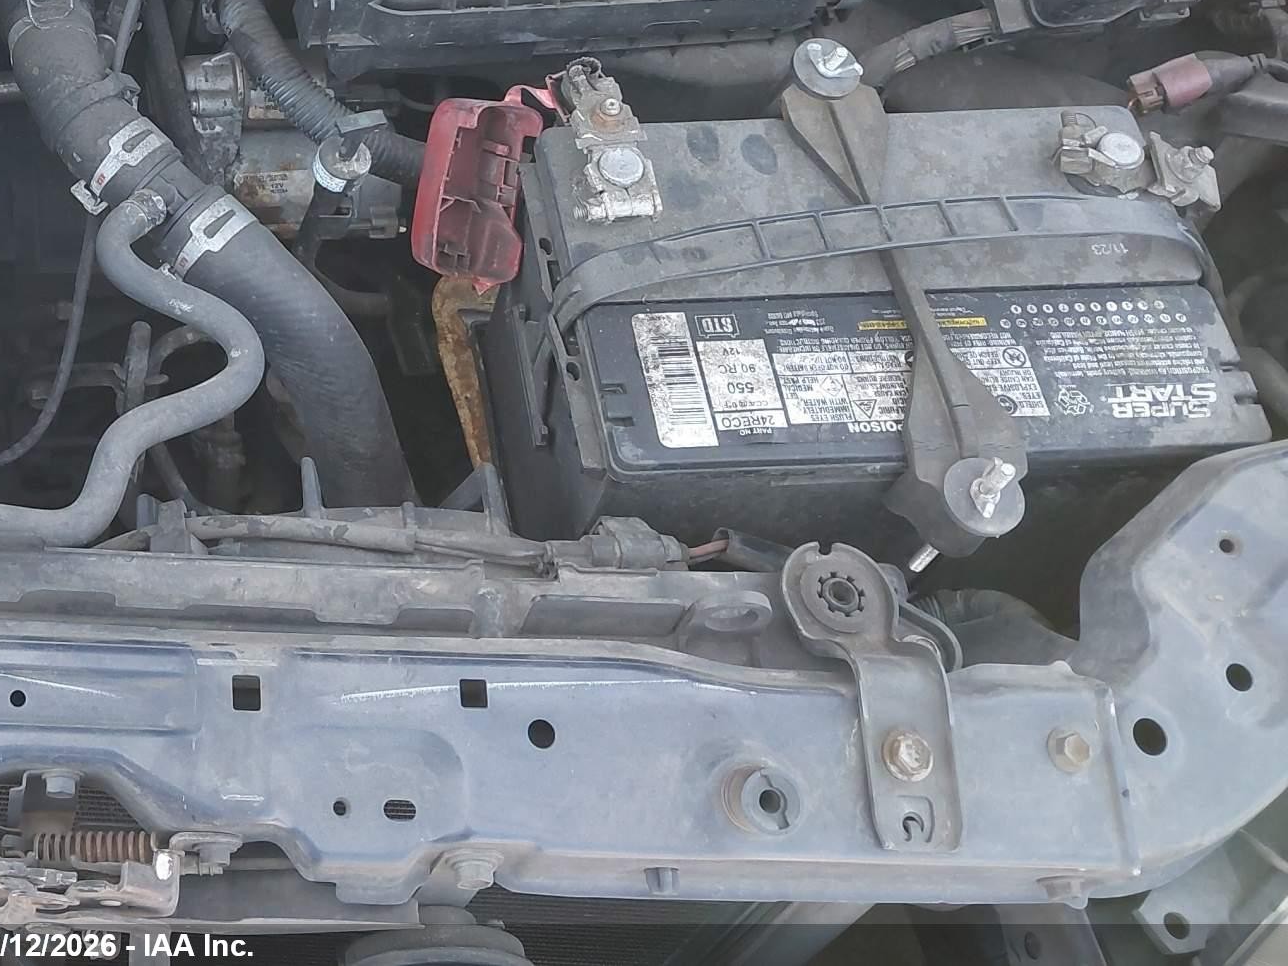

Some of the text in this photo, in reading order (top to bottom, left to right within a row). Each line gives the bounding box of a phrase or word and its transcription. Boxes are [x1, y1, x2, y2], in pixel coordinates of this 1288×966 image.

[1091, 242, 1129, 256] 11/23
[701, 317, 733, 333] STD
[722, 347, 740, 356] 12V
[717, 363, 756, 374] 90 RC
[802, 376, 819, 384] HELP
[727, 382, 754, 394] 550
[782, 384, 813, 392] MEDICAL
[1000, 383, 1038, 392] EXPLOSIVE
[1106, 383, 1217, 403] START
[747, 400, 768, 408] CCA
[829, 397, 849, 406] WITH
[802, 405, 851, 414] IMMEDIATELY
[1111, 401, 1211, 419] SUPER
[721, 415, 775, 428] 24RECO
[810, 413, 853, 422] FLUSH EYES
[753, 427, 772, 435] PART
